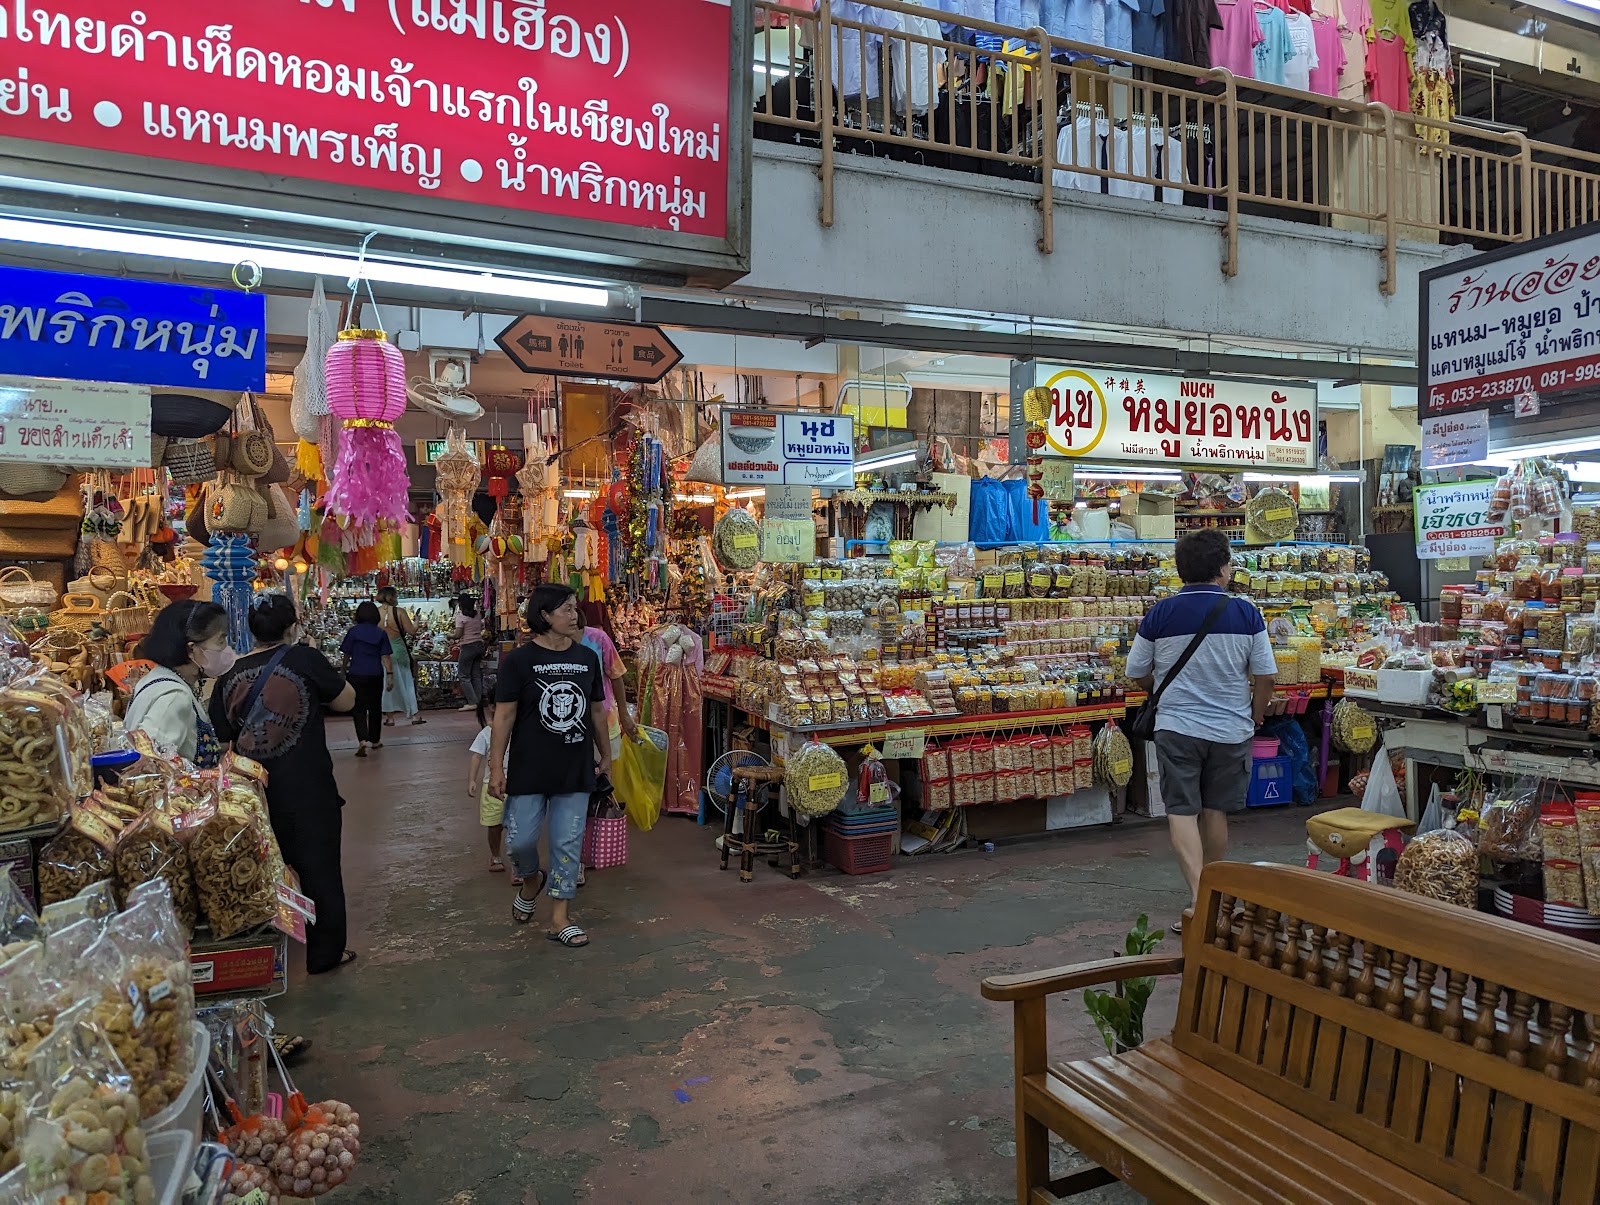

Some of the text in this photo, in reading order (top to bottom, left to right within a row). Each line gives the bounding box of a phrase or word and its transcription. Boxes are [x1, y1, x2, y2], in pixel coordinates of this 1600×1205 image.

[143, 101, 443, 190] แหนมพรเพ็ญ
[495, 132, 706, 232] น้ำพริกหนุ่ม
[0, 291, 259, 379] พริกหนุ่ม
[1535, 328, 1600, 357] น้ำพริก
[637, 349, 655, 360] 食品
[558, 360, 629, 373] Toilet Food
[1180, 381, 1215, 399] NUCH
[1051, 387, 1093, 446] นุช
[1122, 390, 1311, 458] หมูยอหนัง
[800, 419, 835, 442] นุช
[787, 442, 850, 458] หมูยอหนัง
[1190, 439, 1265, 465] น้ำพริกหนุ่ม
[1427, 488, 1494, 505] น้ำพริกหนุ่
[1438, 529, 1501, 540] 081-9982541
[532, 662, 589, 673] TRANSFORMERS
